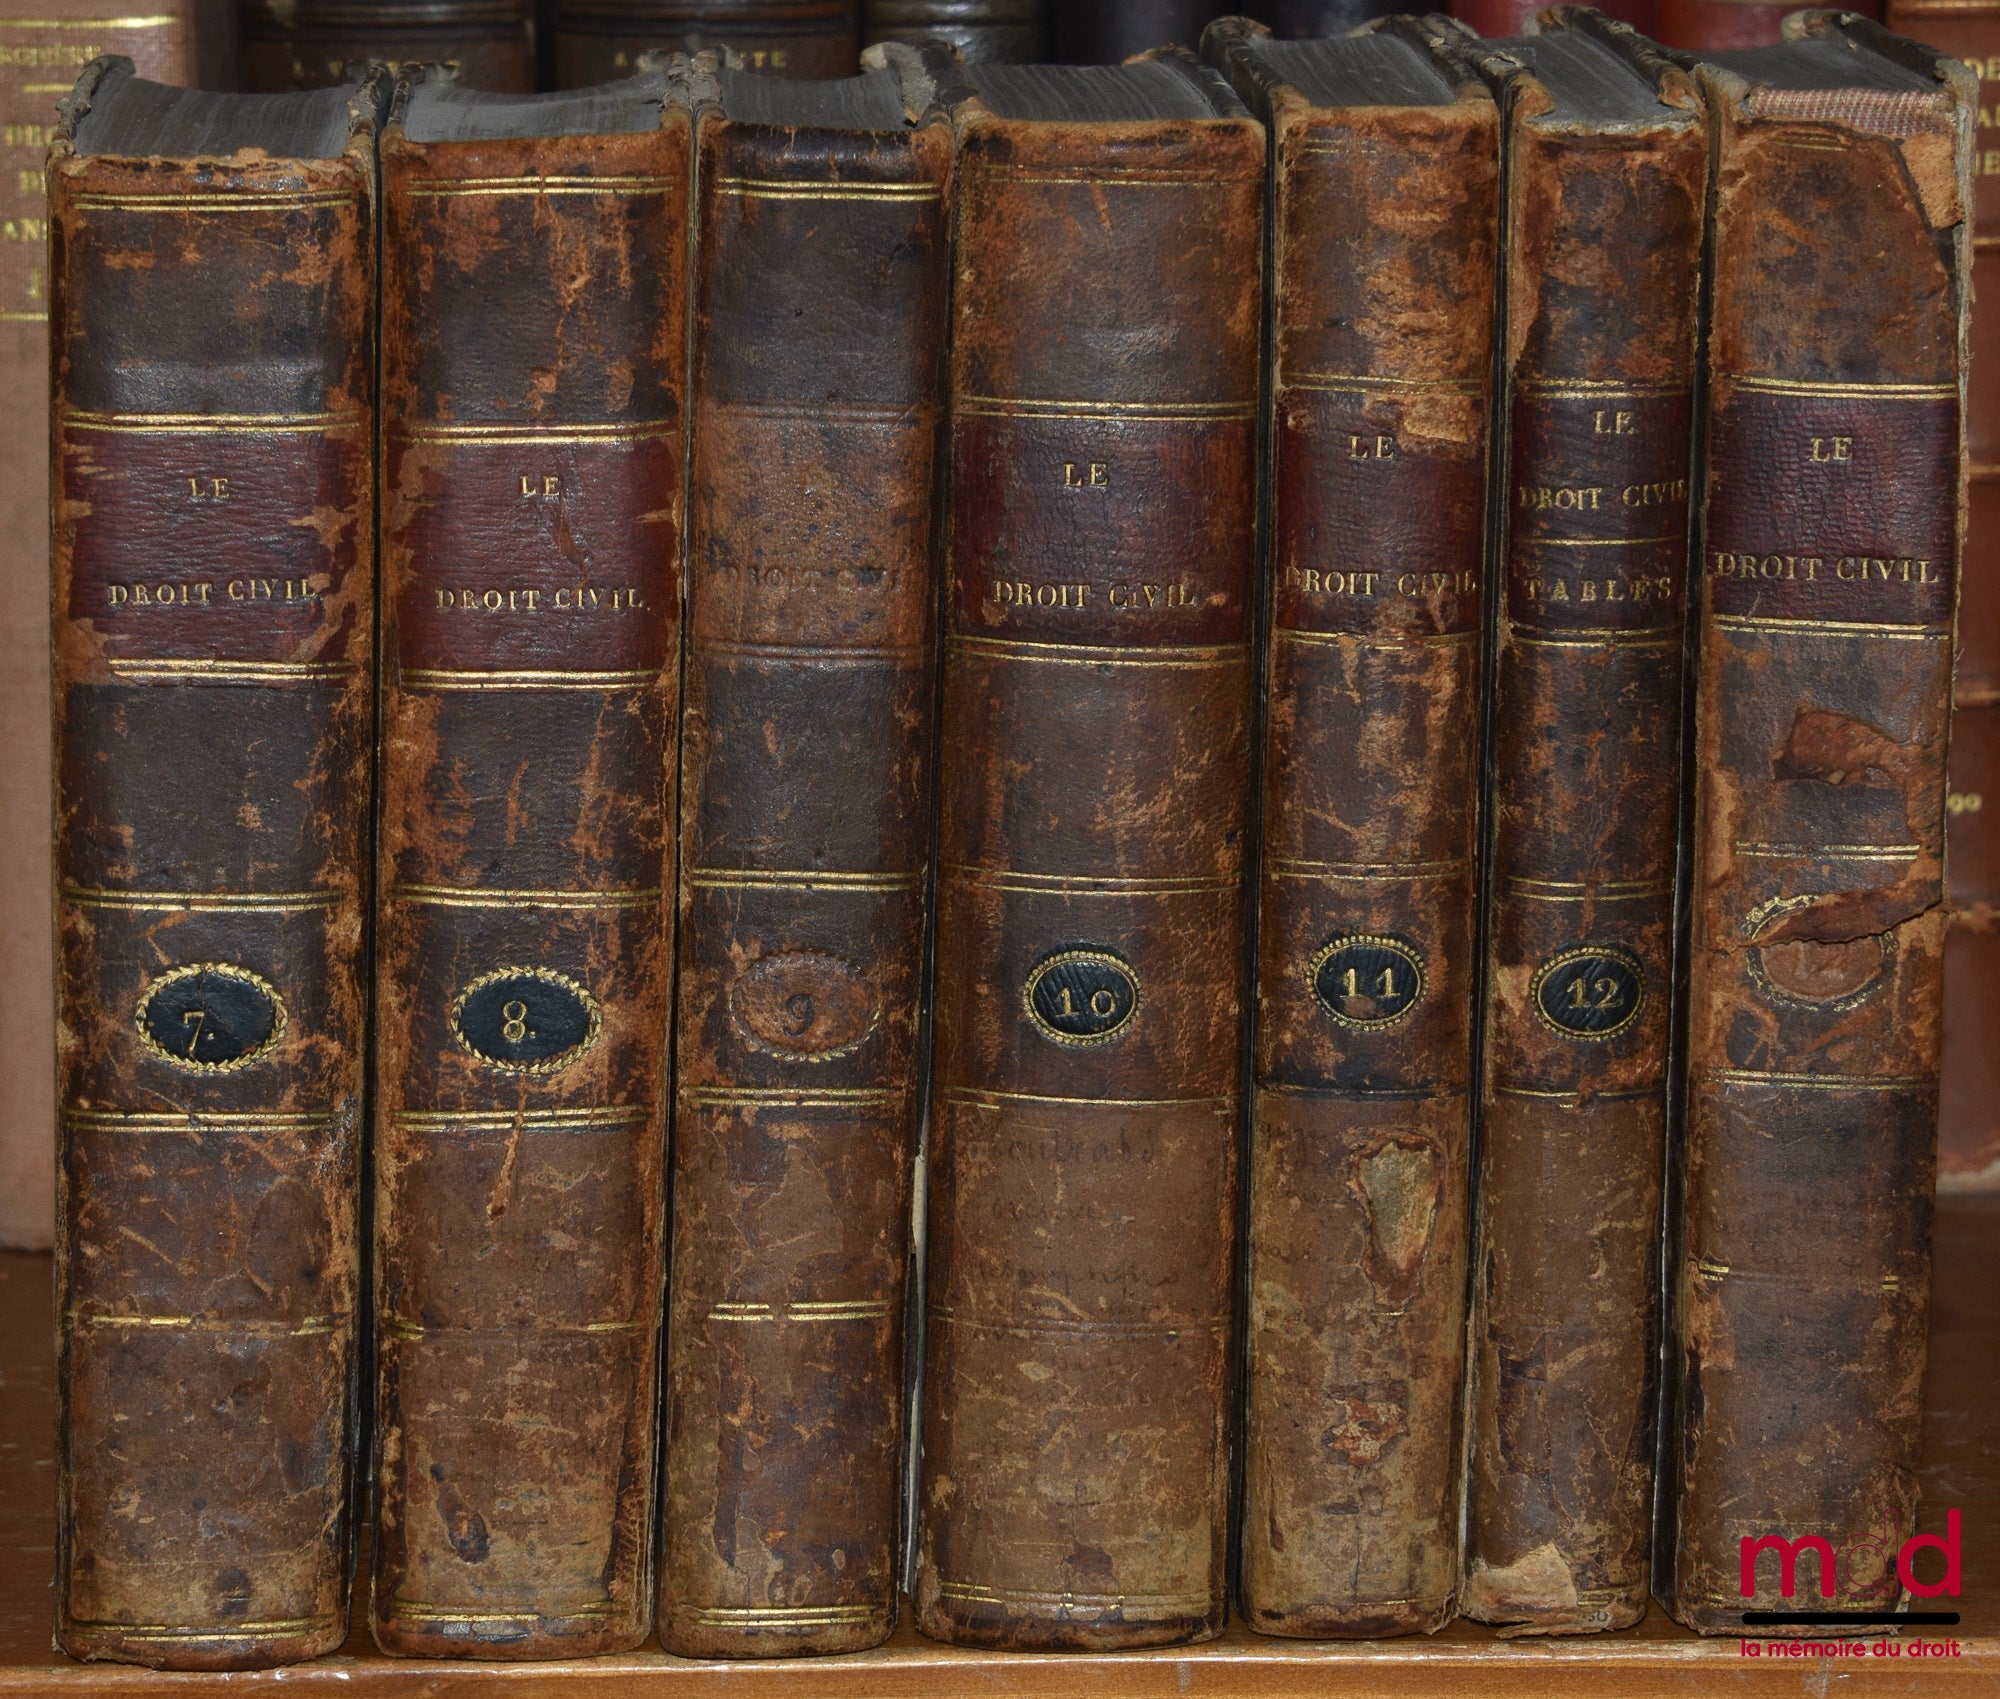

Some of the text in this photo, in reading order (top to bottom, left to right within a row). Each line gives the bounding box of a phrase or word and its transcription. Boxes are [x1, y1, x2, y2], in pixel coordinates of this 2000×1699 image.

[1594, 411, 1634, 434] LE
[1351, 436, 1393, 459] LE
[1810, 437, 1853, 462] LE
[520, 475, 560, 496] LE
[1064, 463, 1108, 487] LE
[188, 478, 229, 498] LE
[1519, 487, 1602, 510] DROIT
[1714, 552, 1940, 584] DROIT CIVIL
[110, 578, 318, 605] DROIT CIVIL
[1285, 566, 1379, 596] DROIT
[1525, 577, 1671, 602] TABLES
[437, 589, 539, 611] DROIT
[994, 581, 1195, 608] DROIT CIVIL
[1340, 967, 1401, 998] 11
[1566, 977, 1624, 1009] 12
[1055, 986, 1116, 1018] 10
[783, 993, 816, 1038] 9
